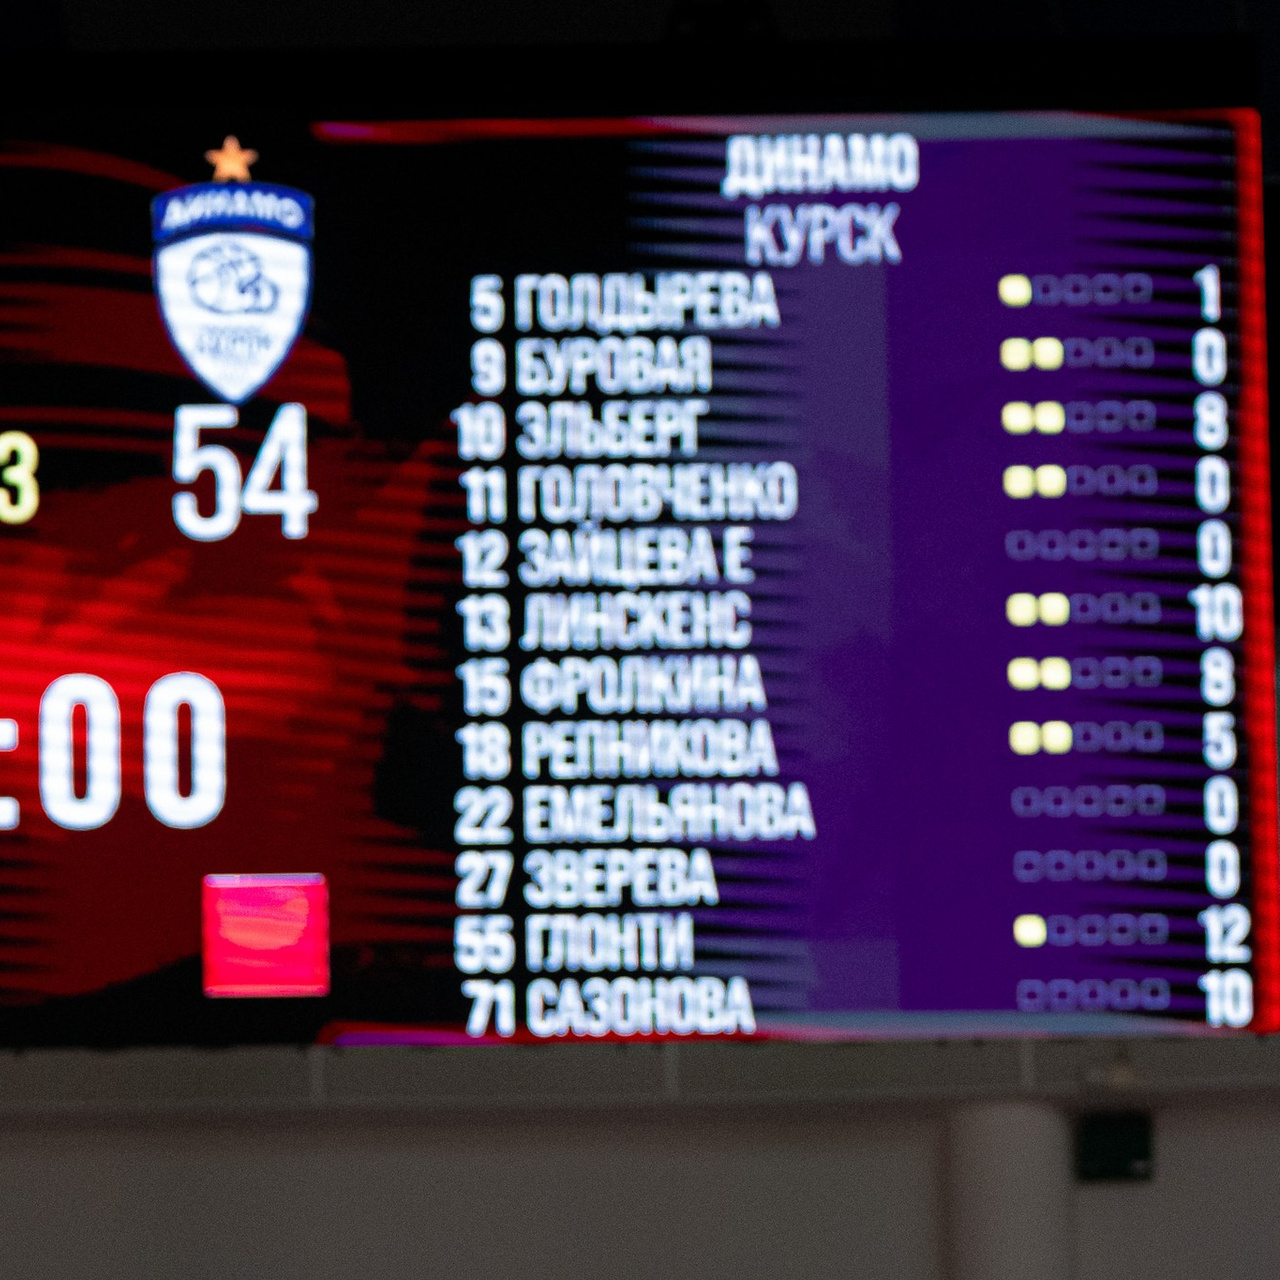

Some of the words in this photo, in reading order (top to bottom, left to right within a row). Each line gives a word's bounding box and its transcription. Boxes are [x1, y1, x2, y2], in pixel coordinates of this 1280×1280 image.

[722, 133, 919, 198] ДИНАМО
[745, 205, 900, 264] КУРСК
[471, 275, 504, 332] 5
[515, 272, 780, 331] ГОЛДЫРЕВА
[1196, 267, 1220, 319] 1
[470, 339, 506, 396] 9
[516, 337, 712, 393] БУРОВАЯ
[1193, 328, 1227, 383] 0
[452, 401, 506, 460] 10
[1194, 393, 1228, 448] 8
[173, 403, 317, 541] 54
[457, 467, 506, 524] 11
[517, 462, 798, 524] ГОЛОВЧЕНКО
[1196, 456, 1230, 512] 0
[457, 529, 509, 588] 12
[519, 522, 718, 586] ЗАЙЦЕВА
[722, 526, 753, 583] Е
[1197, 521, 1231, 576] 0
[457, 594, 510, 651] 13
[521, 591, 752, 648] ЛИНСКЕНС
[1190, 584, 1243, 639] 10
[458, 658, 511, 714] 15
[520, 655, 766, 713] ФРОЛКИНА
[1201, 649, 1234, 705] 8
[457, 722, 511, 780] 18
[1202, 712, 1236, 768] 5
[453, 786, 513, 845] 22
[523, 782, 815, 842] ЕМЕЛЬЯНОВА
[1204, 777, 1238, 833] 0
[453, 850, 513, 909] 27
[524, 848, 718, 907] ЗВЕРЕВА
[1206, 841, 1240, 897] 0
[453, 915, 515, 971] 55
[525, 913, 694, 970] ГЛОНТИ
[1200, 905, 1250, 963] 12
[461, 979, 515, 1037] 71
[526, 977, 756, 1037] САЗОНОВА
[1199, 969, 1253, 1028] 10
